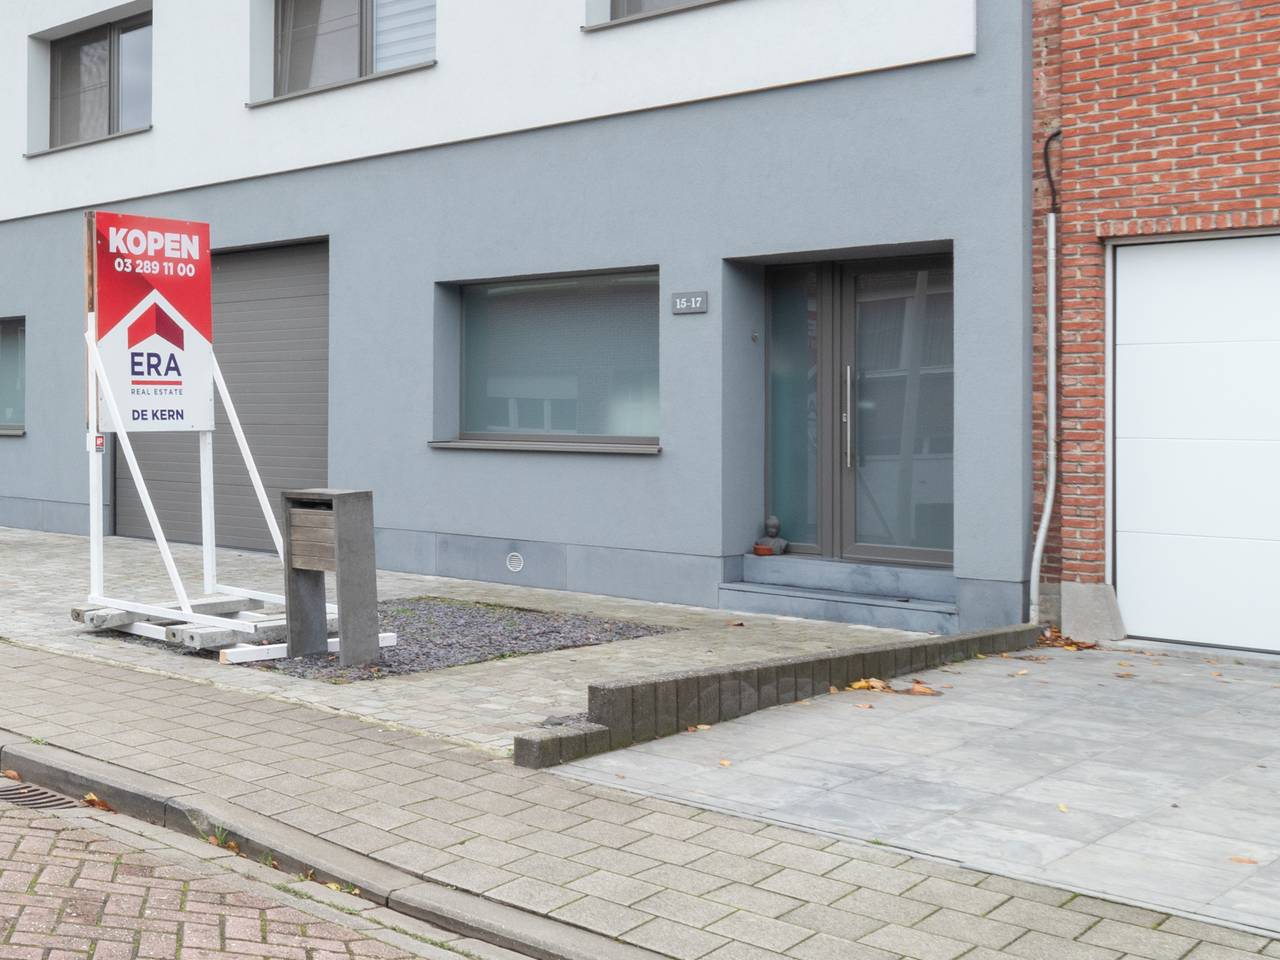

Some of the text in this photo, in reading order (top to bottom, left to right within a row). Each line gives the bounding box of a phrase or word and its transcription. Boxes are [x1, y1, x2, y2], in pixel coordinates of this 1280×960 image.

[108, 226, 200, 260] KOPEN
[114, 257, 196, 277] 03 289 11 00
[675, 297, 702, 309] 15-17
[130, 351, 182, 377] ERA
[130, 388, 184, 396] REAL ESTATE
[131, 409, 185, 421] DE KERN
